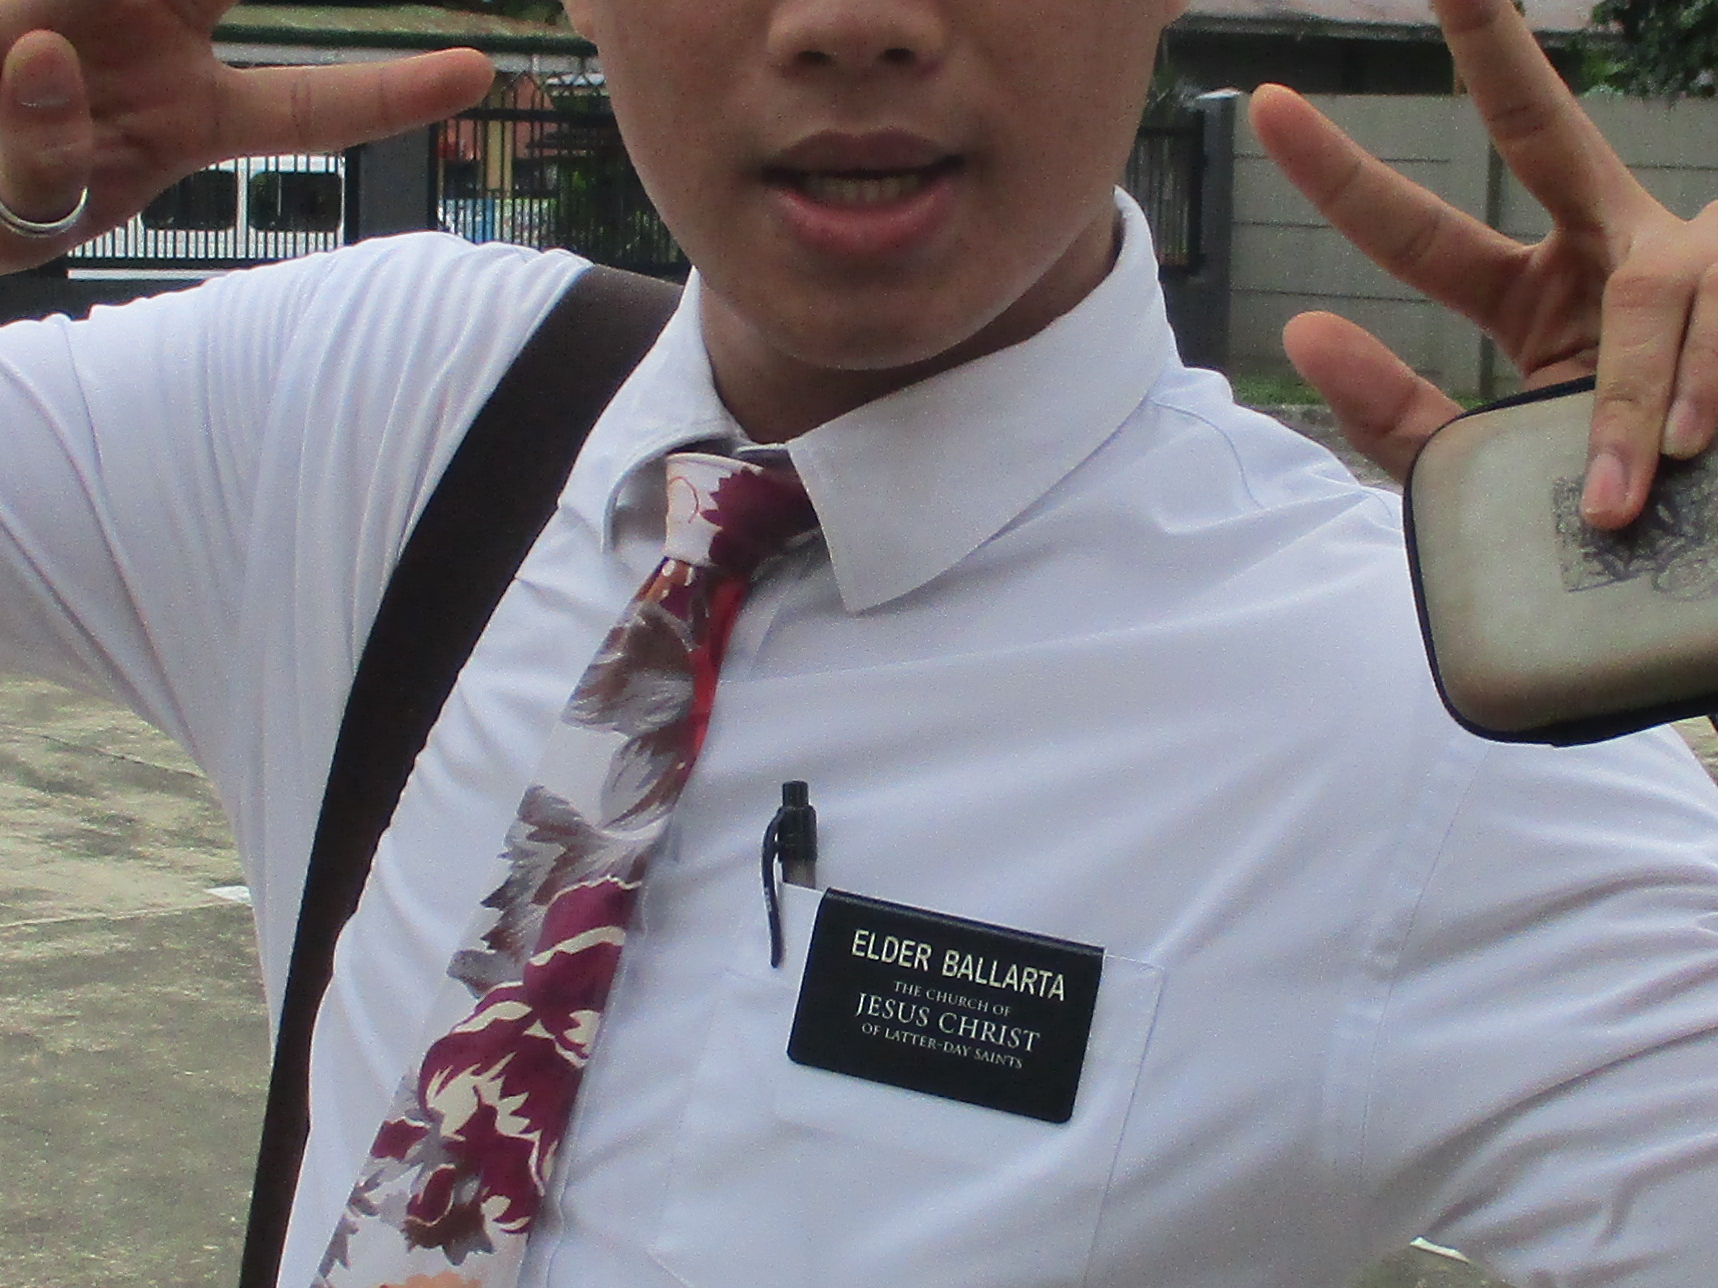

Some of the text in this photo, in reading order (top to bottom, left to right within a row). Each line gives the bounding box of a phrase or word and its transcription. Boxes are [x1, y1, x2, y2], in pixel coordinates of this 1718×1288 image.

[851, 929, 1066, 1002] ELDER BALLARTA
[855, 992, 1041, 1053] JESUS CHRIST
[893, 980, 1012, 1018] THE CHURCH OF
[861, 1022, 1024, 1070] OF LATTER-DAY SAINTS
